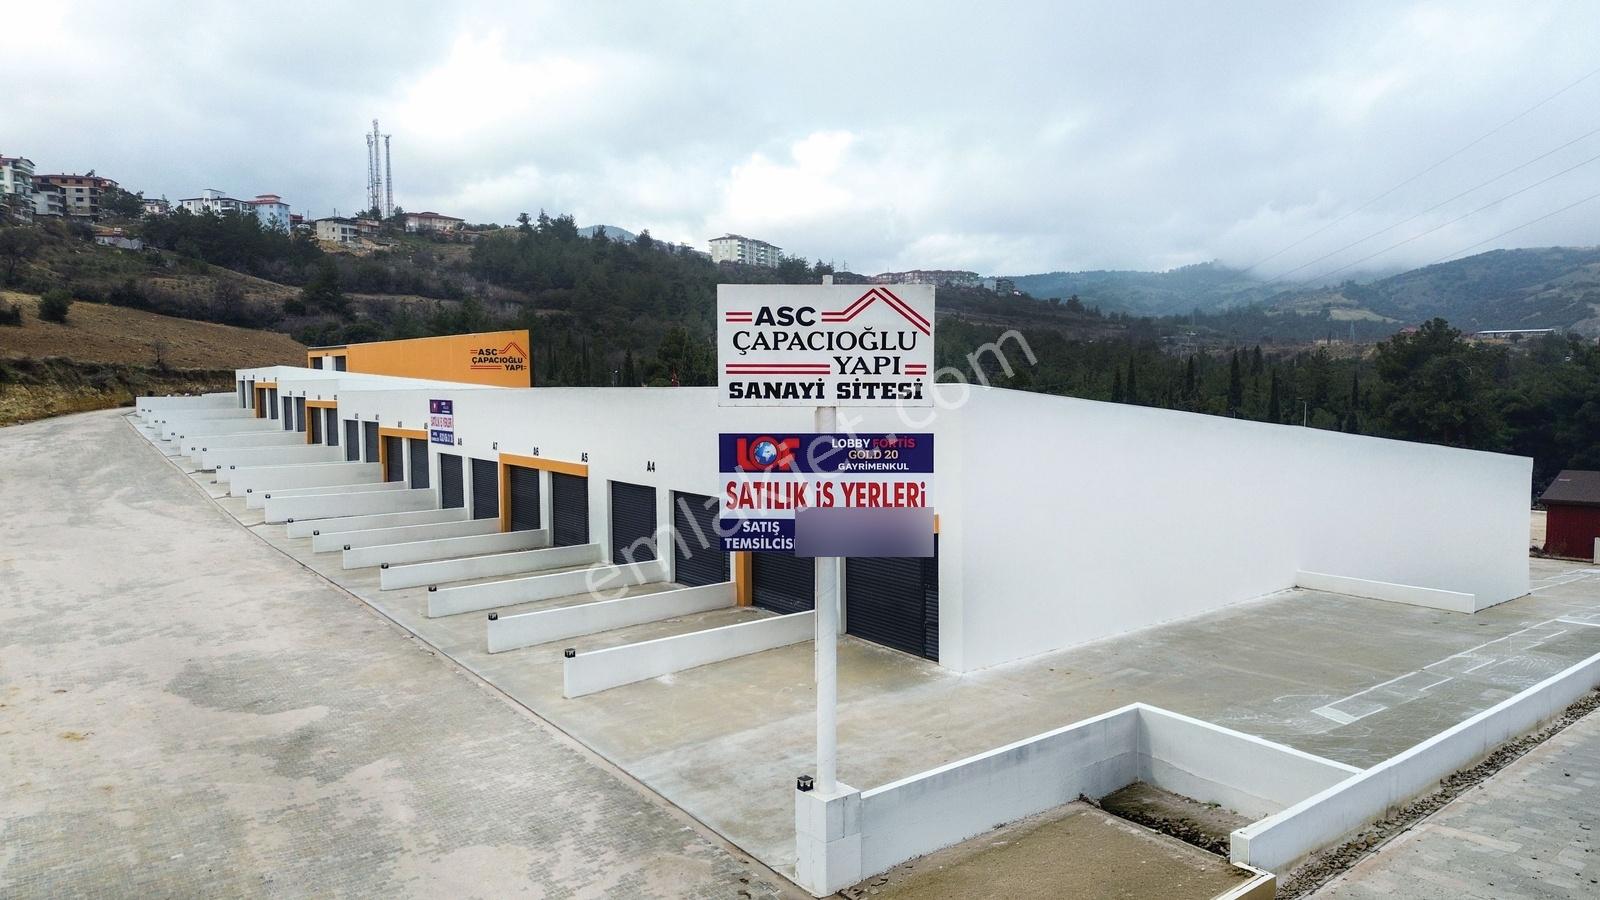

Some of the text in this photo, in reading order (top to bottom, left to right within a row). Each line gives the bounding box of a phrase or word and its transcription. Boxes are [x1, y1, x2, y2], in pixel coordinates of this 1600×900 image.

[754, 306, 817, 327] ASC
[732, 327, 918, 356] ÇAPACIOĞLU
[478, 348, 498, 356] ASC
[833, 356, 902, 375] YAPI
[729, 378, 923, 400] SANAYİ SİTESİ
[831, 436, 916, 449] LOBBY FORTİS
[581, 451, 589, 463] A5
[848, 449, 899, 460] GOLD 20
[646, 460, 656, 473] A4
[837, 460, 910, 471] GAYRİMENKUL
[725, 480, 809, 510] SATILIK
[742, 520, 780, 536] SATIŞ
